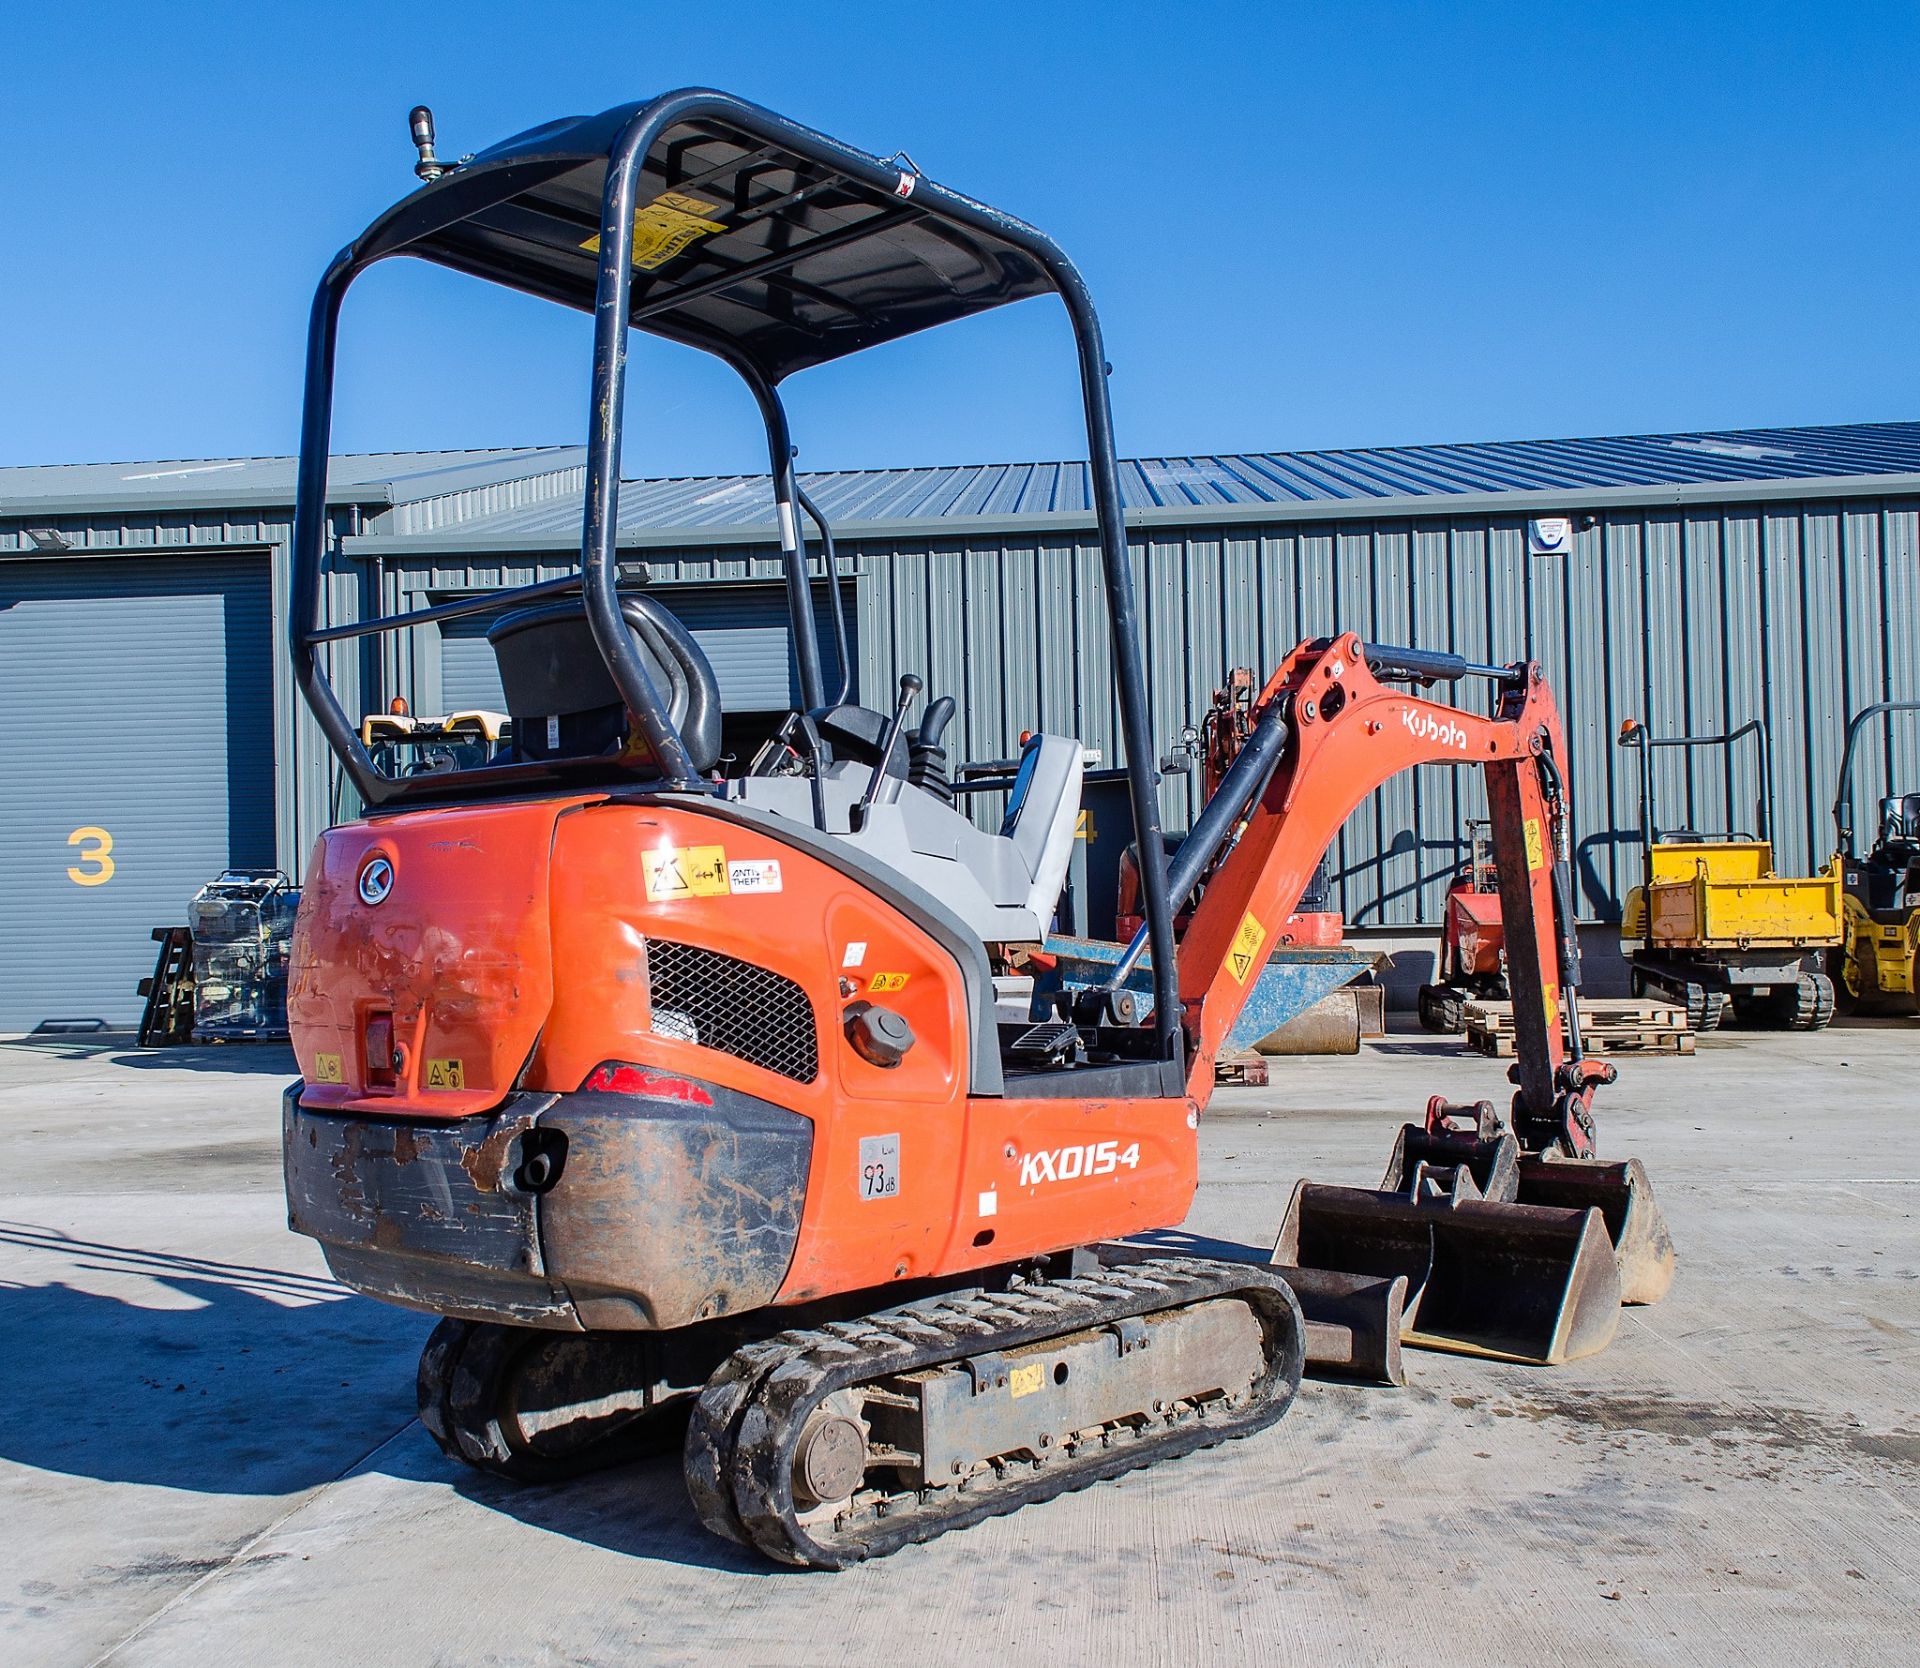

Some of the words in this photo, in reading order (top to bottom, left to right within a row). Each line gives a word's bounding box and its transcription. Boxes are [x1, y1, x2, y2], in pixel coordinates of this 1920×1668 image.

[1402, 706, 1467, 750] Kubota
[1073, 809, 1098, 844] 4
[66, 826, 115, 887] 3
[732, 877, 760, 886] THEFT
[864, 1163, 884, 1195] 93
[885, 1176, 895, 1192] dB
